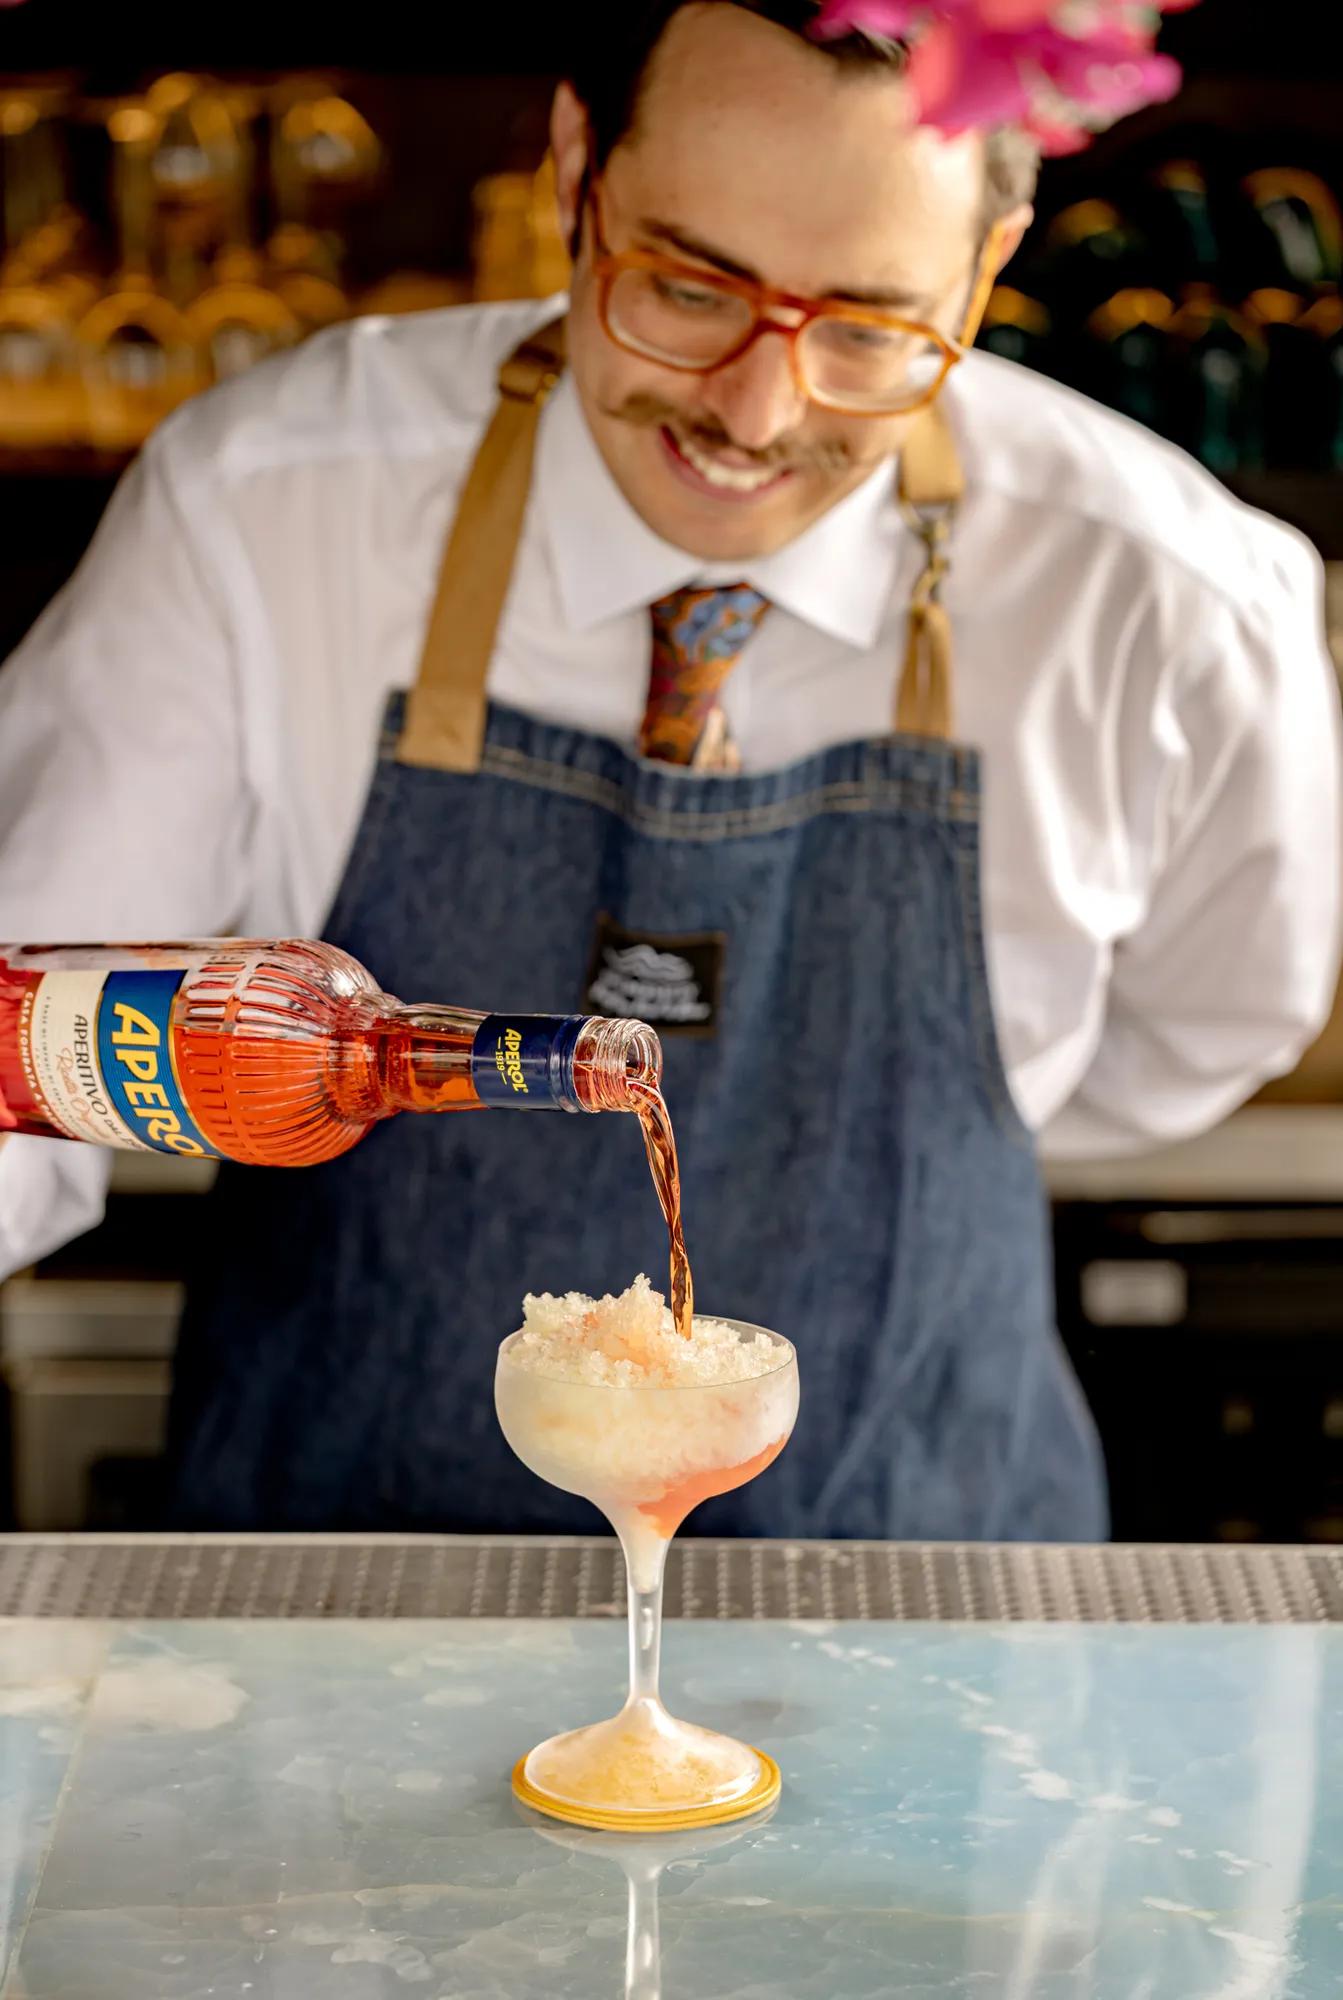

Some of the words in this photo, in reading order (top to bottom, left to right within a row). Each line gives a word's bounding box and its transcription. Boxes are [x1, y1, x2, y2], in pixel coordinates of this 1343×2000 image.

[74, 1014, 108, 1115] APERITIVO
[112, 1002, 221, 1159] APERO
[496, 1051, 505, 1071] 1919
[505, 1028, 528, 1093] APEROL
